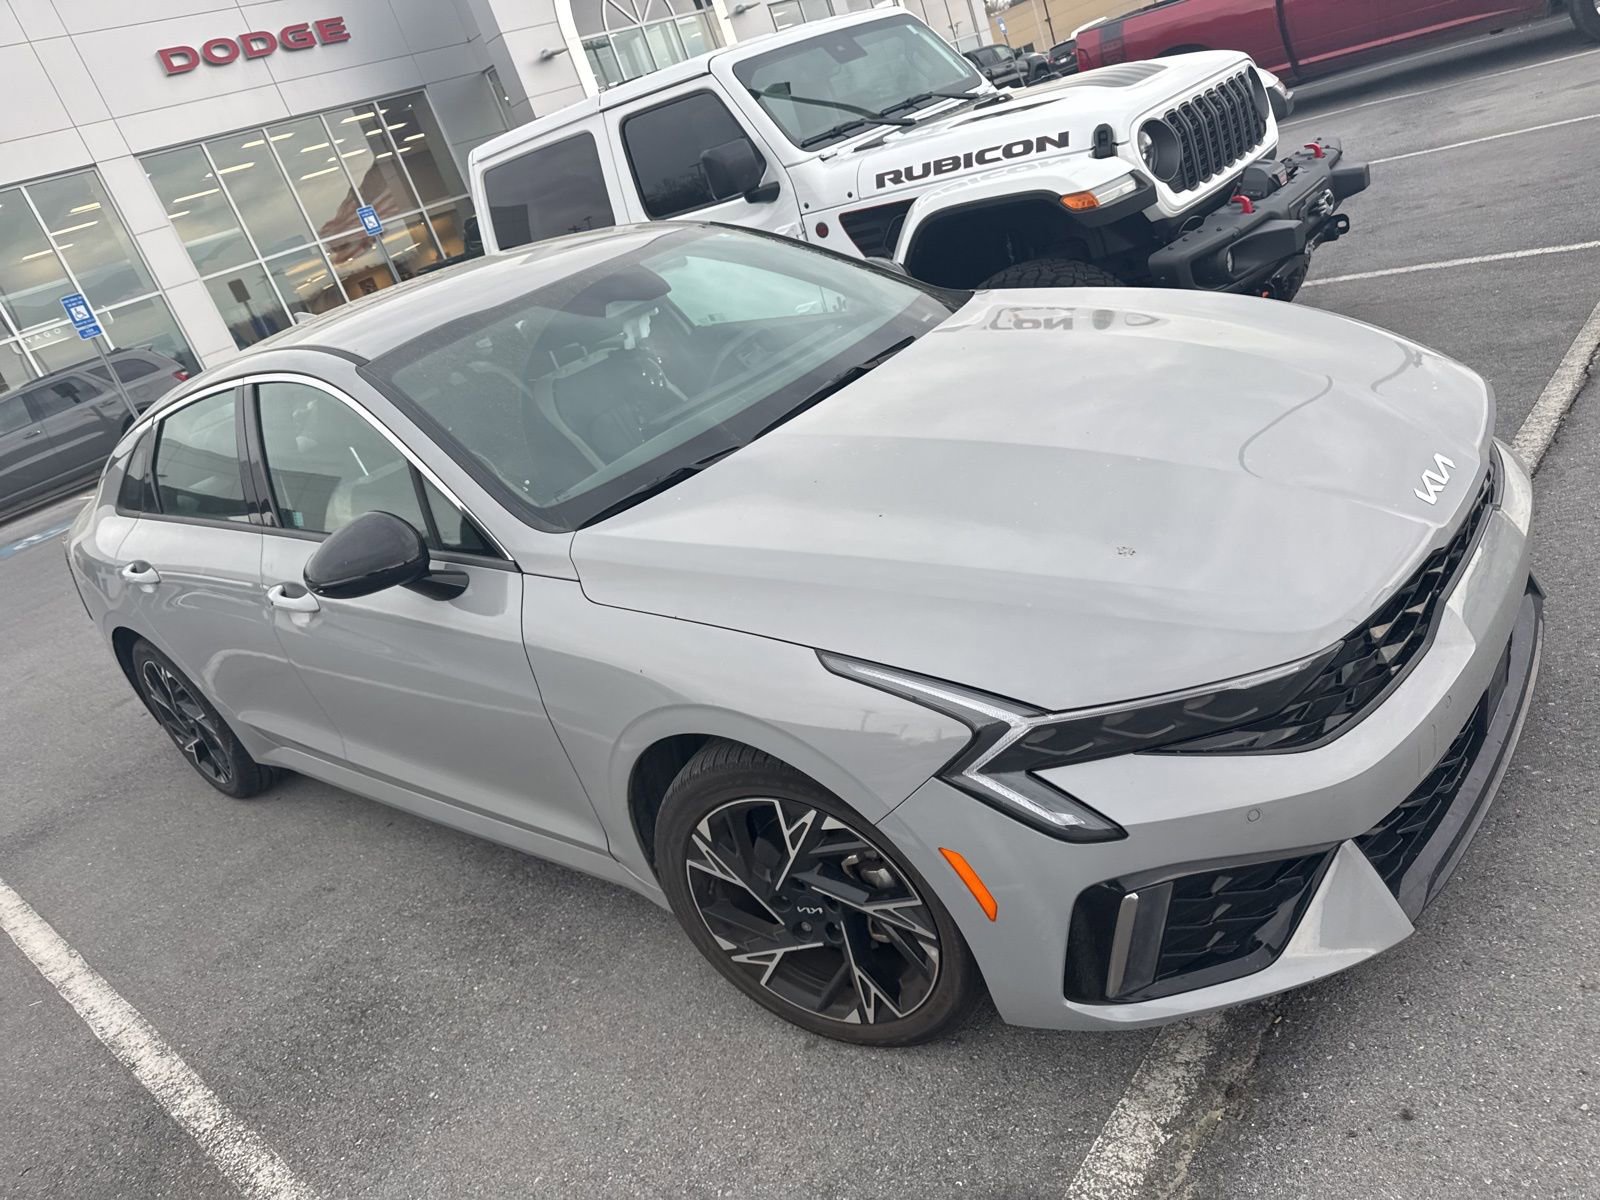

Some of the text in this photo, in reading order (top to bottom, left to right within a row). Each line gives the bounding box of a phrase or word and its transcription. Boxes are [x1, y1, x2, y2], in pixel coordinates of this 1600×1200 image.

[156, 16, 351, 76] DODGE
[876, 131, 1070, 189] RUBICON
[1412, 452, 1456, 505] KIA
